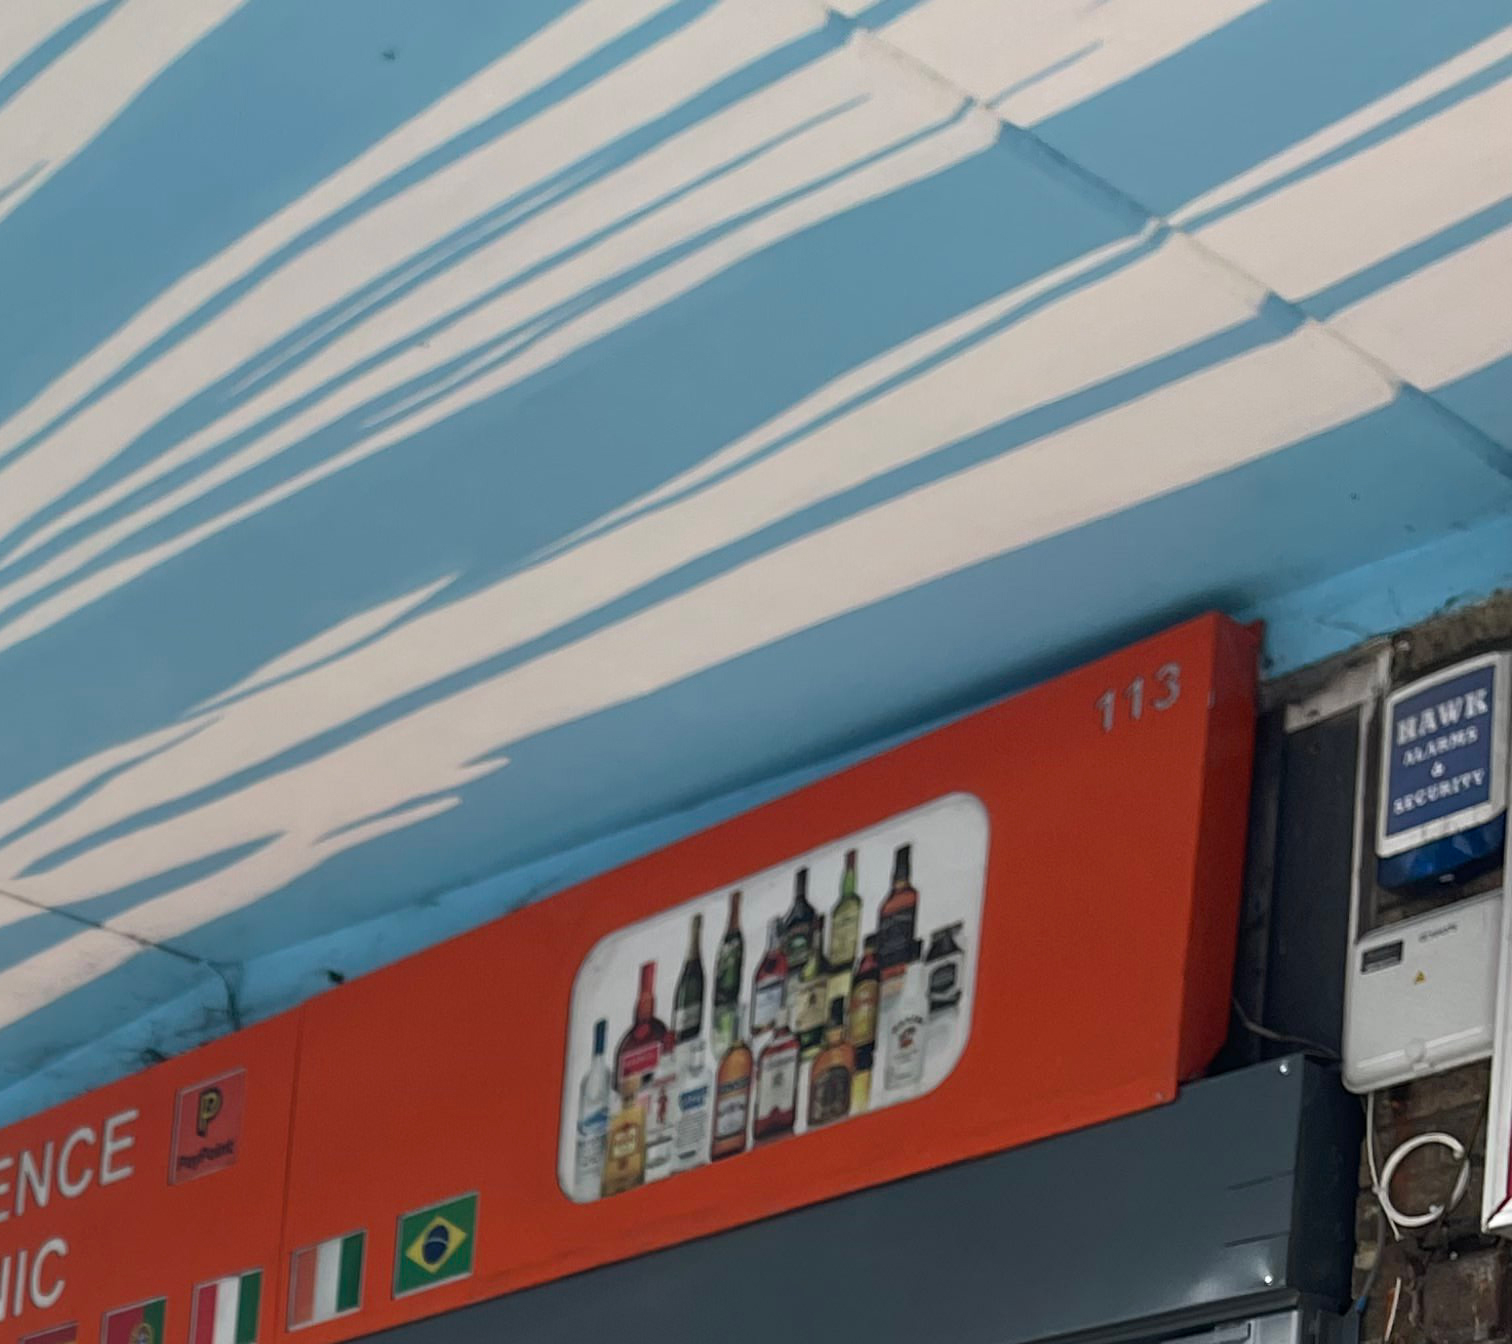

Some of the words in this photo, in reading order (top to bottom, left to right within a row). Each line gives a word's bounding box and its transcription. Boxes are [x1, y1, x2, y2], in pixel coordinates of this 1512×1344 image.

[1093, 661, 1182, 735] 113
[1396, 687, 1488, 745] HAWK
[1402, 725, 1479, 766] ALARMS
[1393, 768, 1486, 816] SECURITY
[1430, 761, 1445, 779] &
